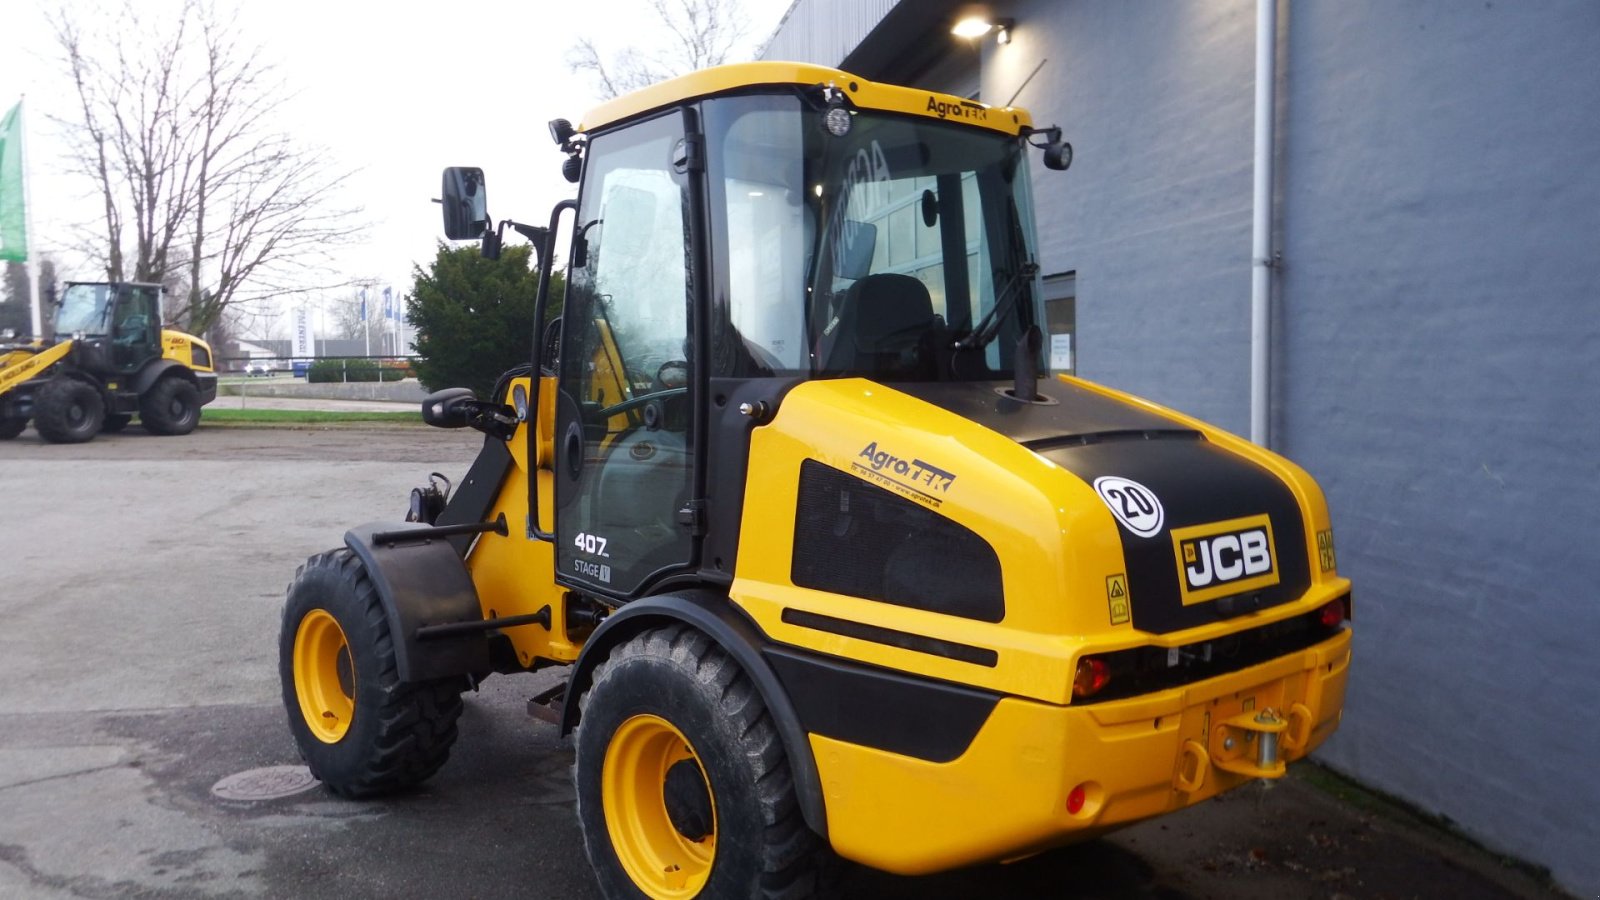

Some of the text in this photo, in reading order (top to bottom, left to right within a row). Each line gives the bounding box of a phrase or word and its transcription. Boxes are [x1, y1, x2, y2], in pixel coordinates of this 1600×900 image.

[859, 442, 956, 492] AgroTEK
[1107, 486, 1154, 519] 20
[574, 532, 607, 556] 407
[1187, 530, 1271, 587] JCB
[574, 559, 600, 578] STAGE
